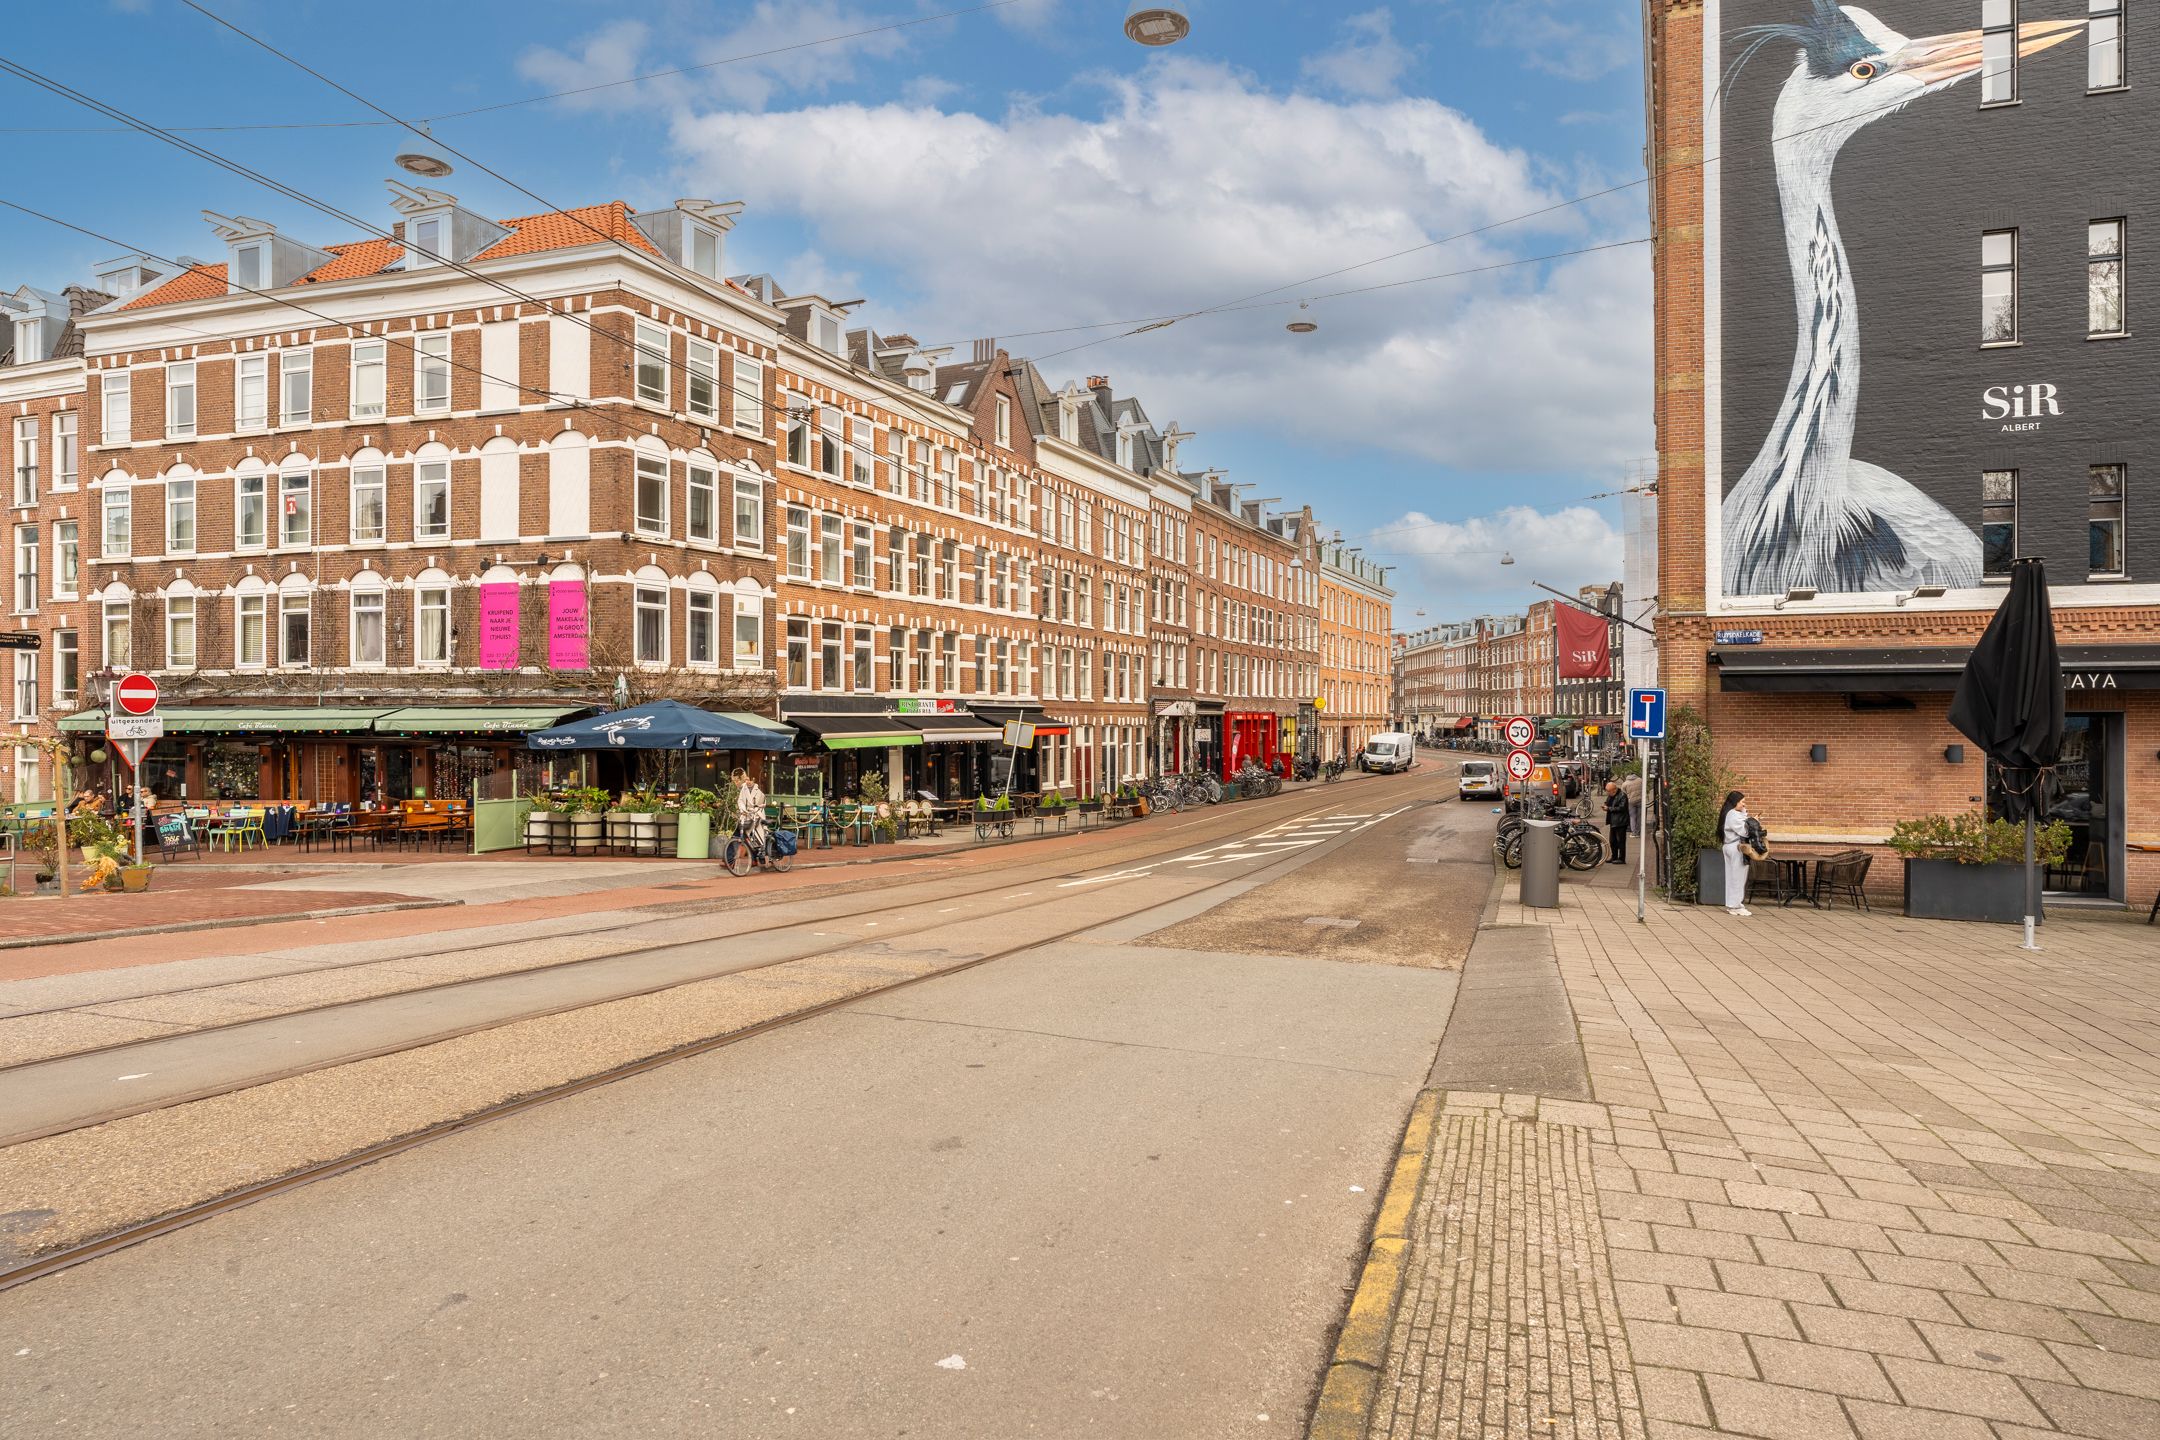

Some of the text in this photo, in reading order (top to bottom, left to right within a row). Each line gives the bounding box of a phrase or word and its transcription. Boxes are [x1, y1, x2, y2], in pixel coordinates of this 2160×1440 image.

[1982, 383, 2064, 420] SiR
[2001, 422, 2041, 432] ALBERT
[1572, 650, 1598, 663] SiR
[2061, 673, 2117, 689] AYA
[111, 717, 161, 726] uitgezonderd
